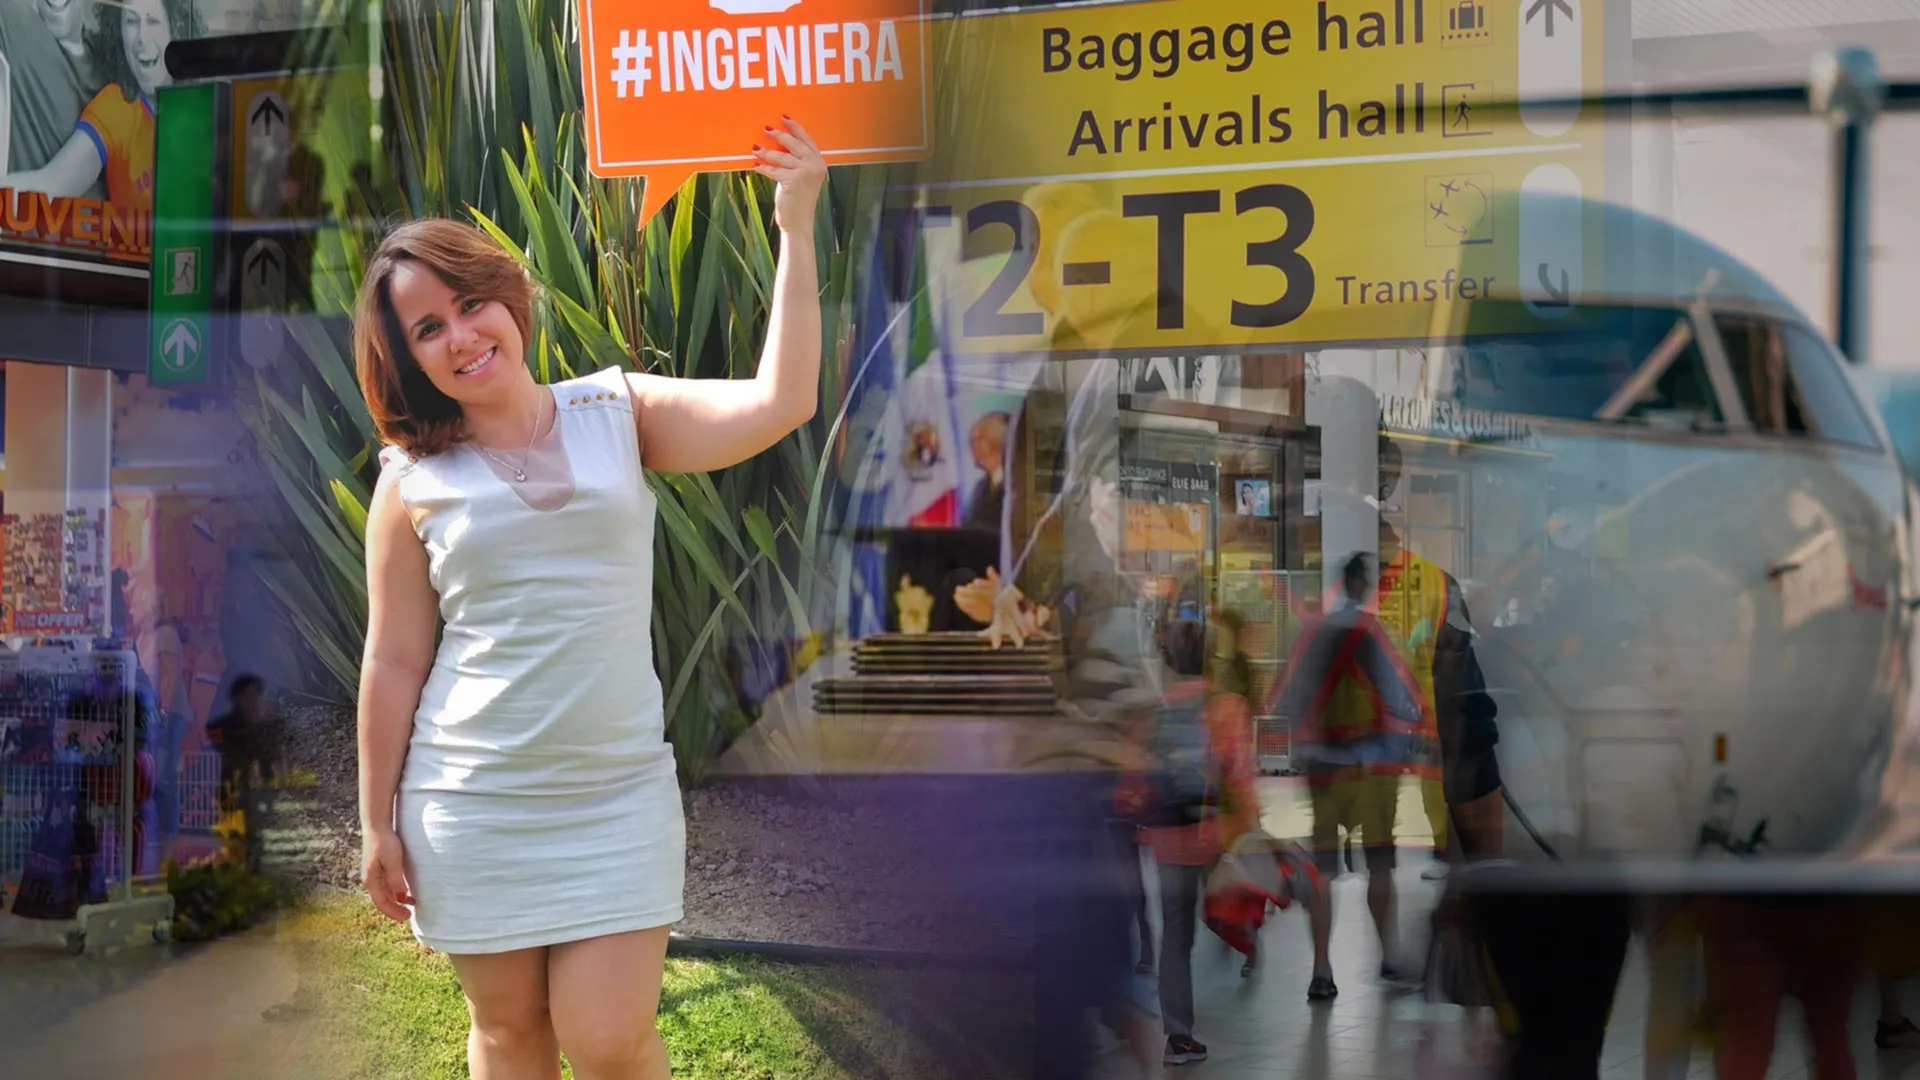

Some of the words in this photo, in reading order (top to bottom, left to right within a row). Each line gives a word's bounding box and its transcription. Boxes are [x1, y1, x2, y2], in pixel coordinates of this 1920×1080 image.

[610, 20, 904, 98] #INGENIERA
[1042, 19, 1291, 80] Baggage
[1317, 0, 1424, 52] hall
[1067, 94, 1292, 157] Arrivals
[1317, 82, 1424, 141] hall
[0, 187, 149, 248] UVENI
[877, 183, 1316, 337] T2-T3
[1336, 269, 1496, 306] Transfer
